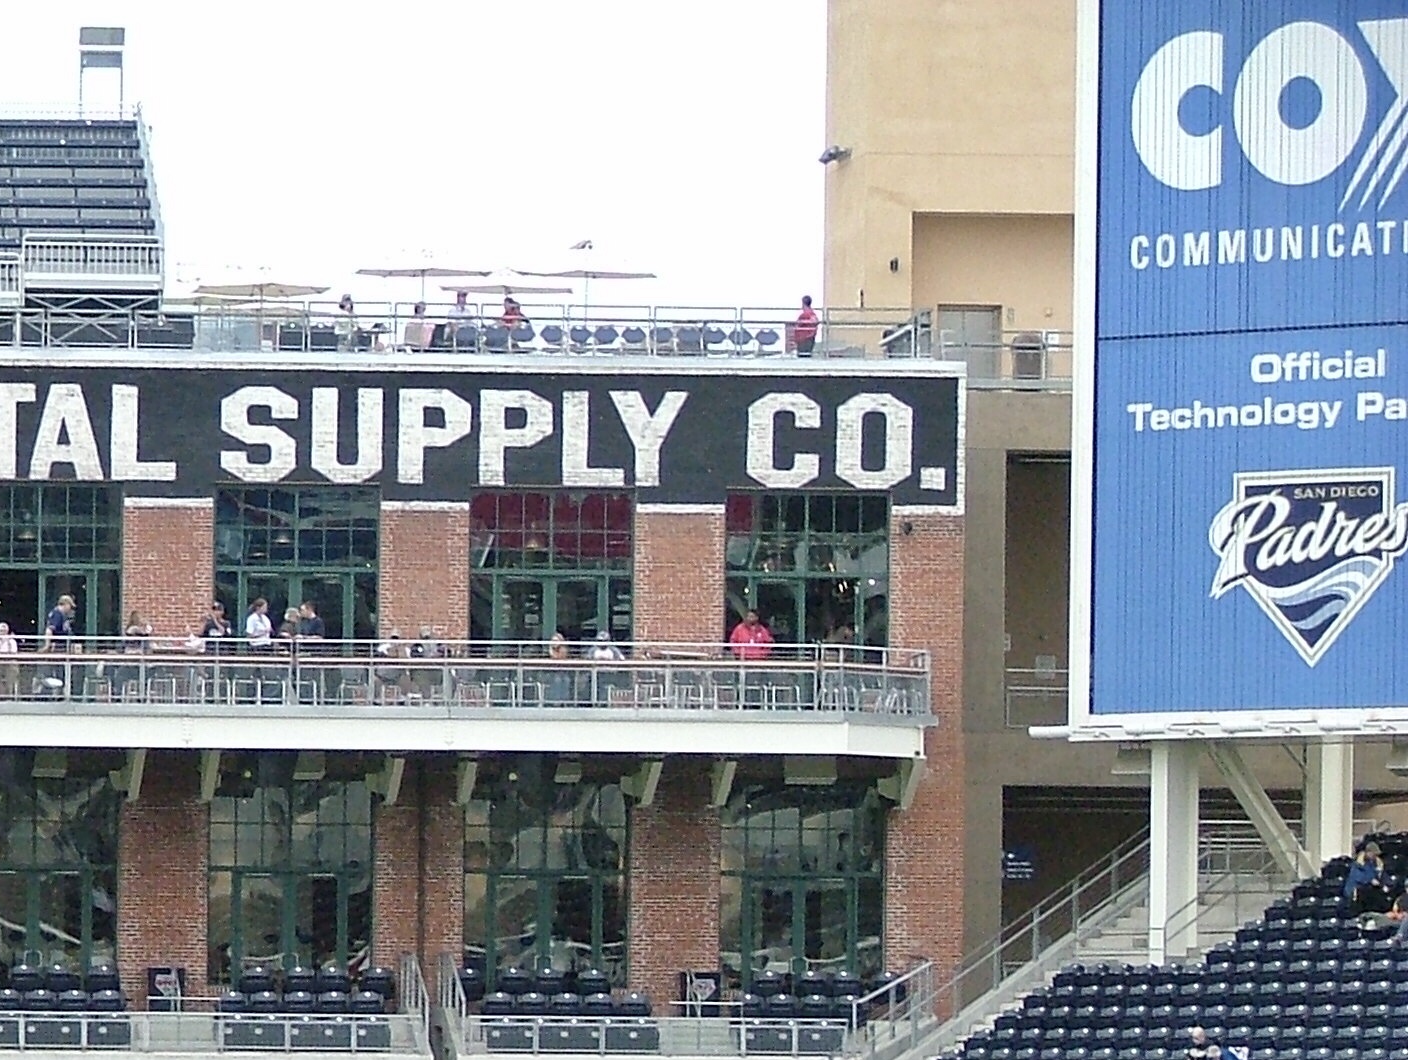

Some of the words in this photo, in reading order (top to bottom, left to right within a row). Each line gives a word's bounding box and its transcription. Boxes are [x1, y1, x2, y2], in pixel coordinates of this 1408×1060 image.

[1250, 348, 1386, 384] Official
[1127, 397, 1343, 431] Technology
[219, 385, 688, 488] SUPPLY
[746, 392, 947, 490] CO.
[1293, 486, 1327, 499] SAN
[1330, 485, 1379, 498] DIEGO
[1210, 488, 1408, 600] Padres
